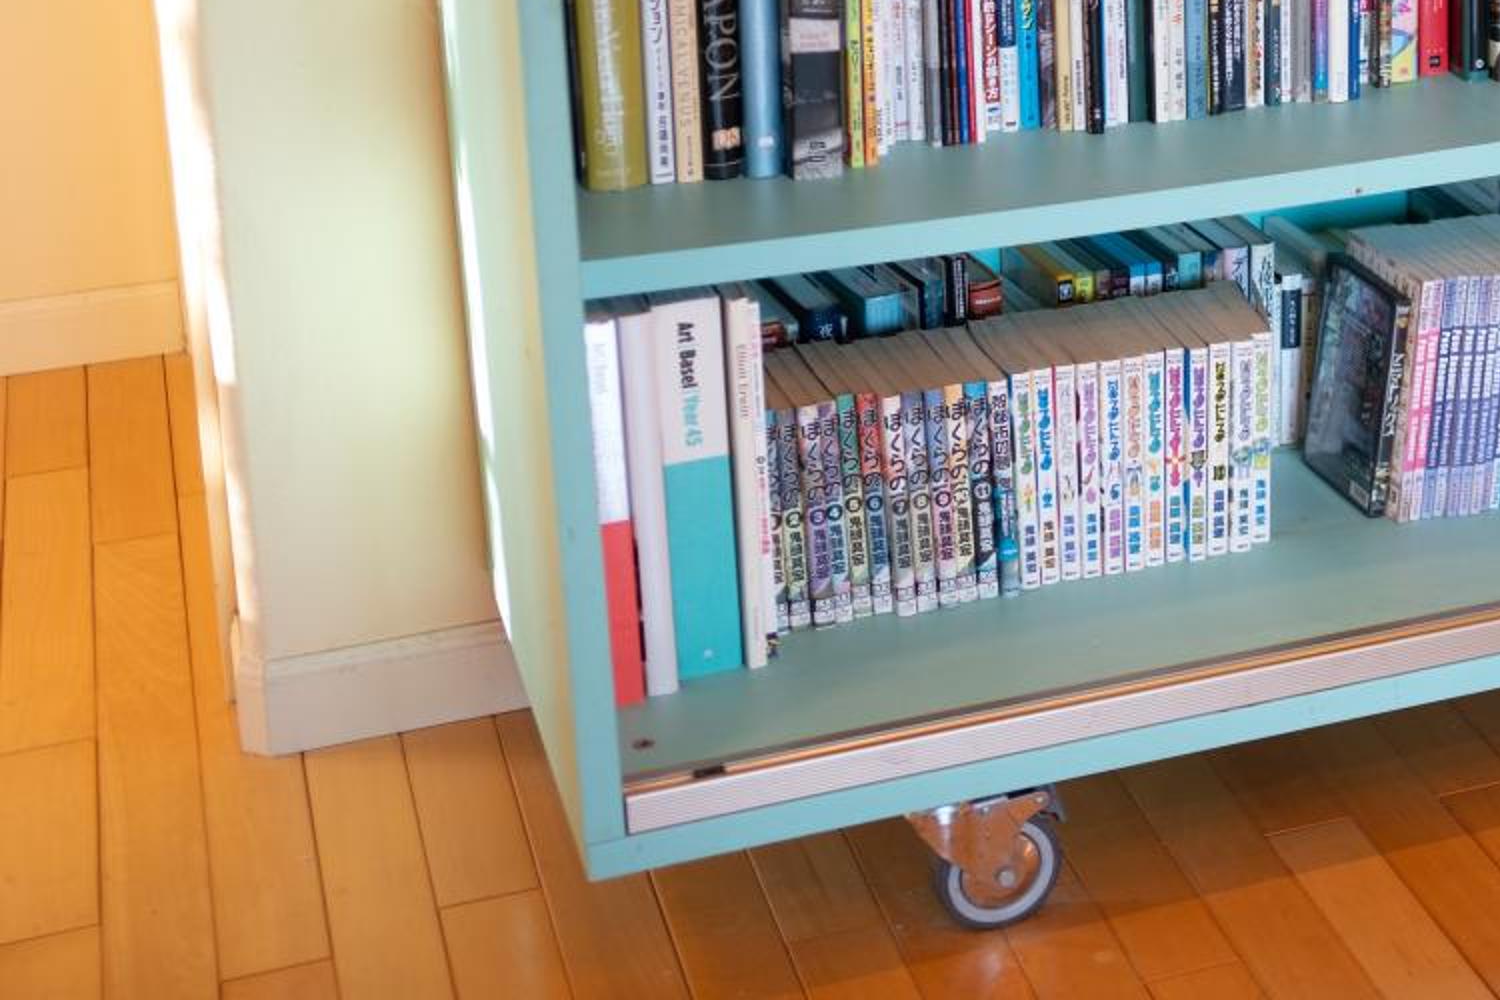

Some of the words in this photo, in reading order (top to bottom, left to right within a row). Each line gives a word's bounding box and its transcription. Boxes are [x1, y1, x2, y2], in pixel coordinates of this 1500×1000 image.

[676, 321, 694, 344] Art
[678, 348, 699, 389] Basel
[841, 409, 863, 495] ぼくらの
[884, 411, 908, 498] ぼくらの
[905, 407, 929, 491] ぼくらの
[946, 398, 969, 487] ぼくらの
